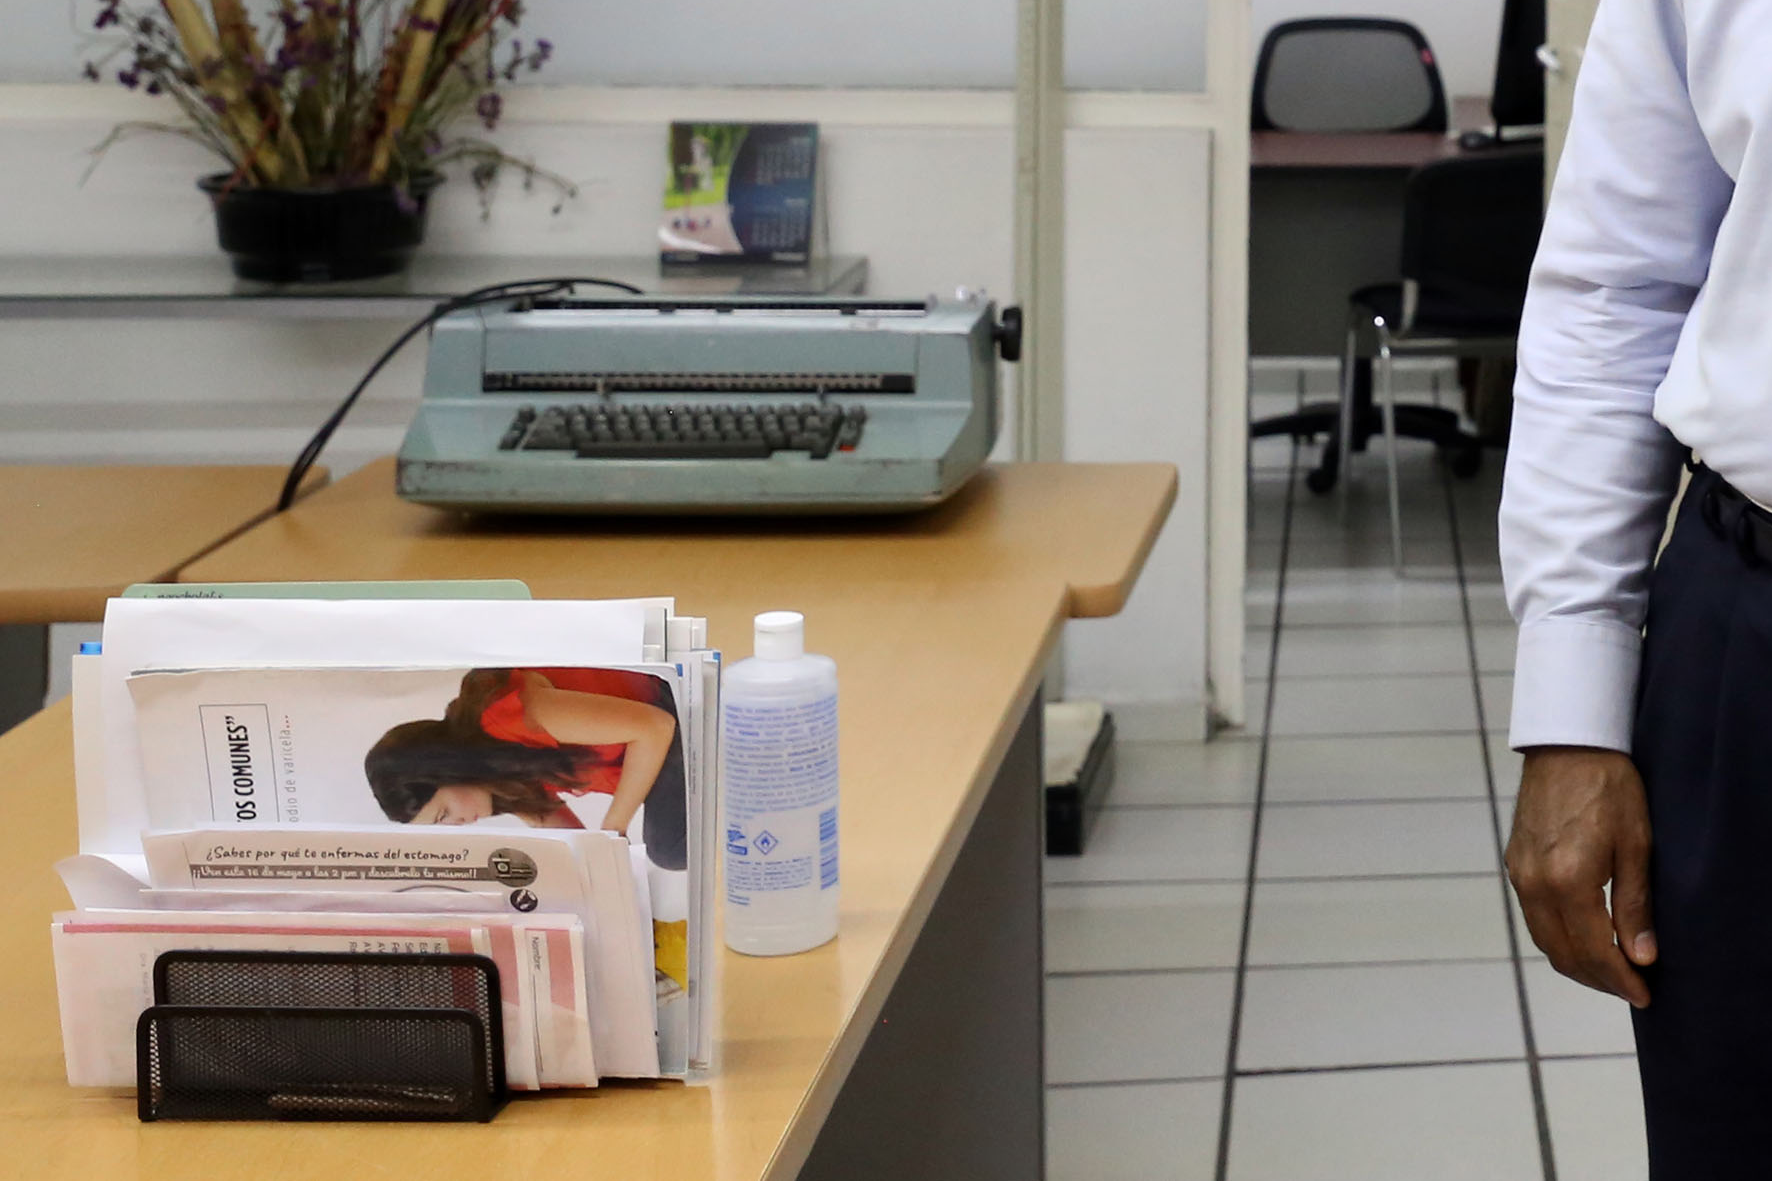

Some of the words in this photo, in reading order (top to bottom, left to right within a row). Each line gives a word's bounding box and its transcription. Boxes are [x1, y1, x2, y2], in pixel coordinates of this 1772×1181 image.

[284, 780, 296, 792] de
[236, 801, 257, 823] OS
[206, 846, 252, 861] ¿Sabes
[256, 851, 275, 861] por
[280, 849, 300, 861] qué
[304, 850, 316, 858] te
[320, 847, 379, 858] enfermas
[384, 849, 400, 859] del
[331, 869, 339, 877] 2
[361, 870, 366, 879] y
